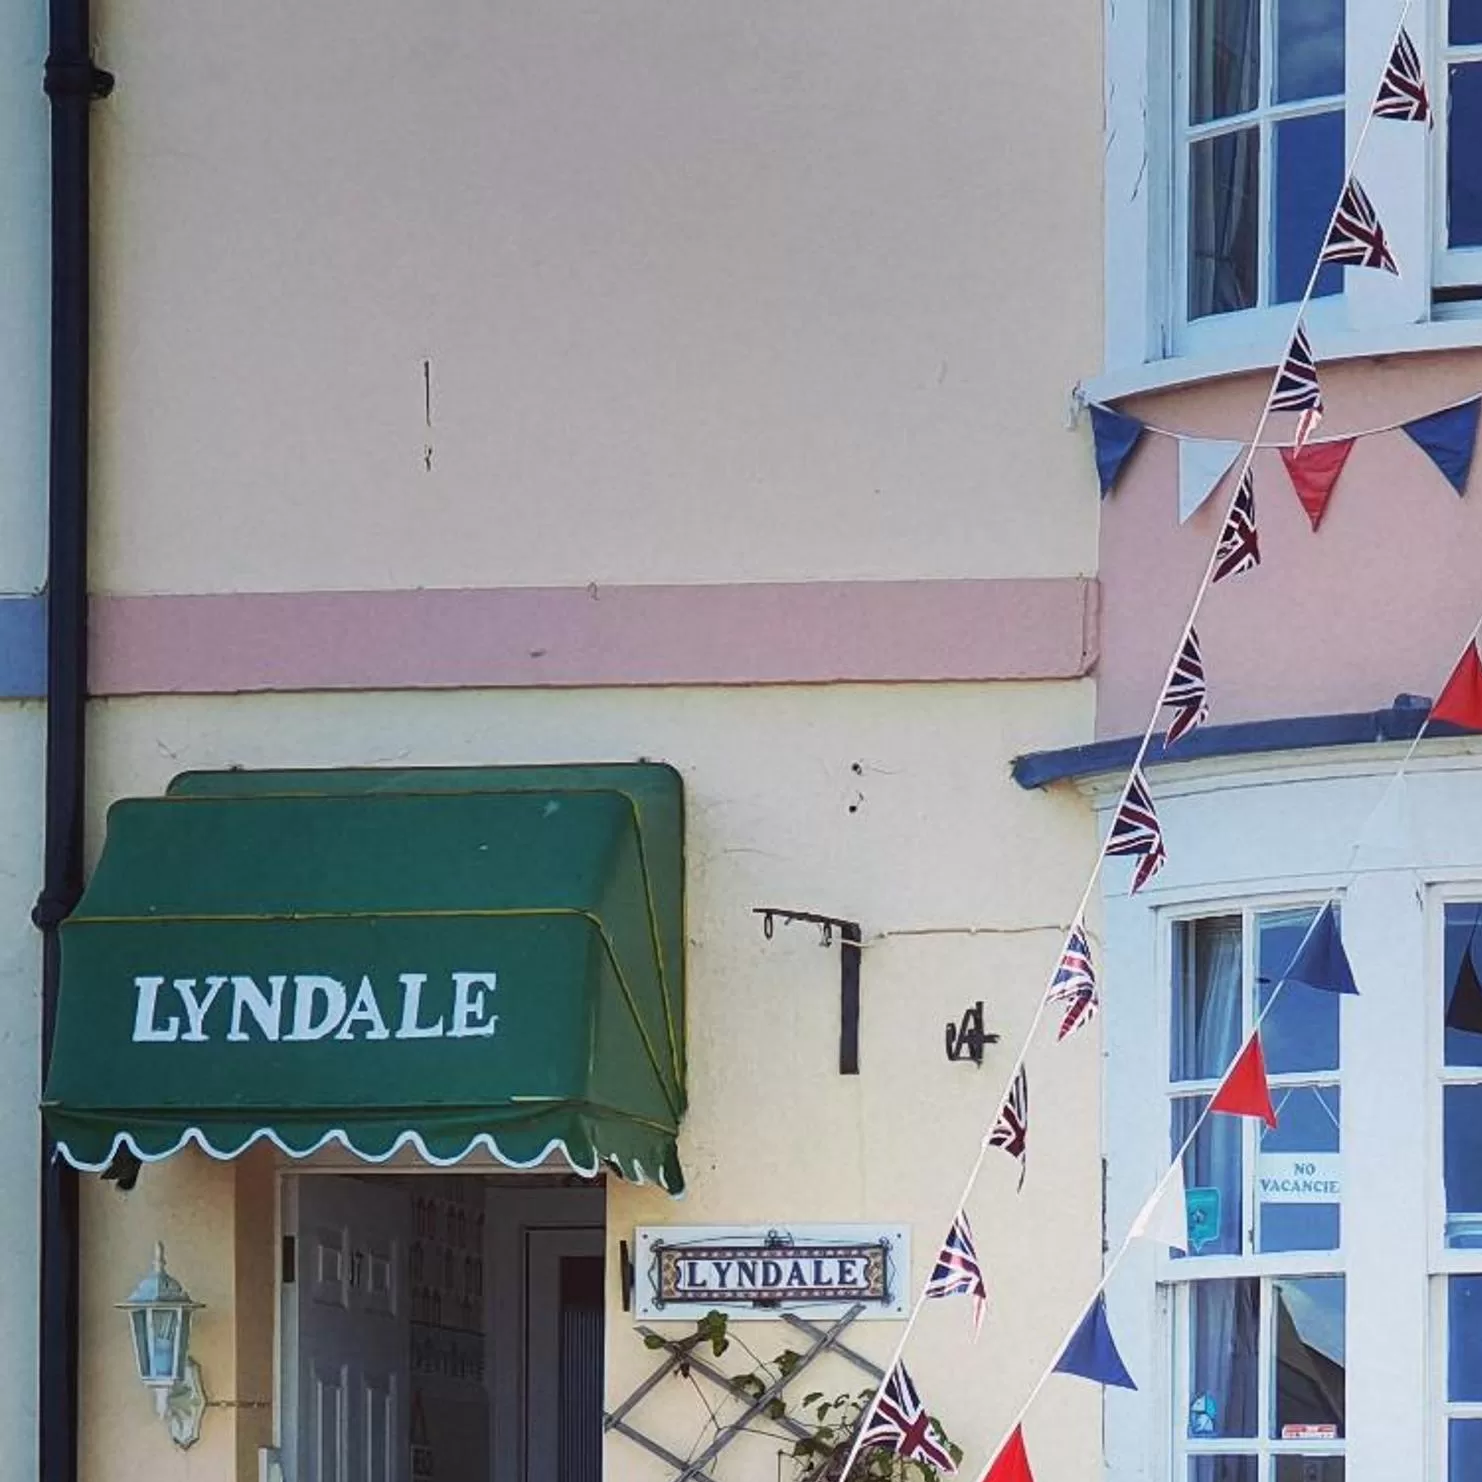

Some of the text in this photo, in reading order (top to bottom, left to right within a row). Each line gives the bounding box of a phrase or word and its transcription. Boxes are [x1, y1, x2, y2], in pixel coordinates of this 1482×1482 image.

[132, 972, 498, 1041] LYNDALE
[1294, 1162, 1316, 1176] NO
[1260, 1179, 1340, 1193] VACANCIE
[687, 1260, 857, 1287] LYNDALE
